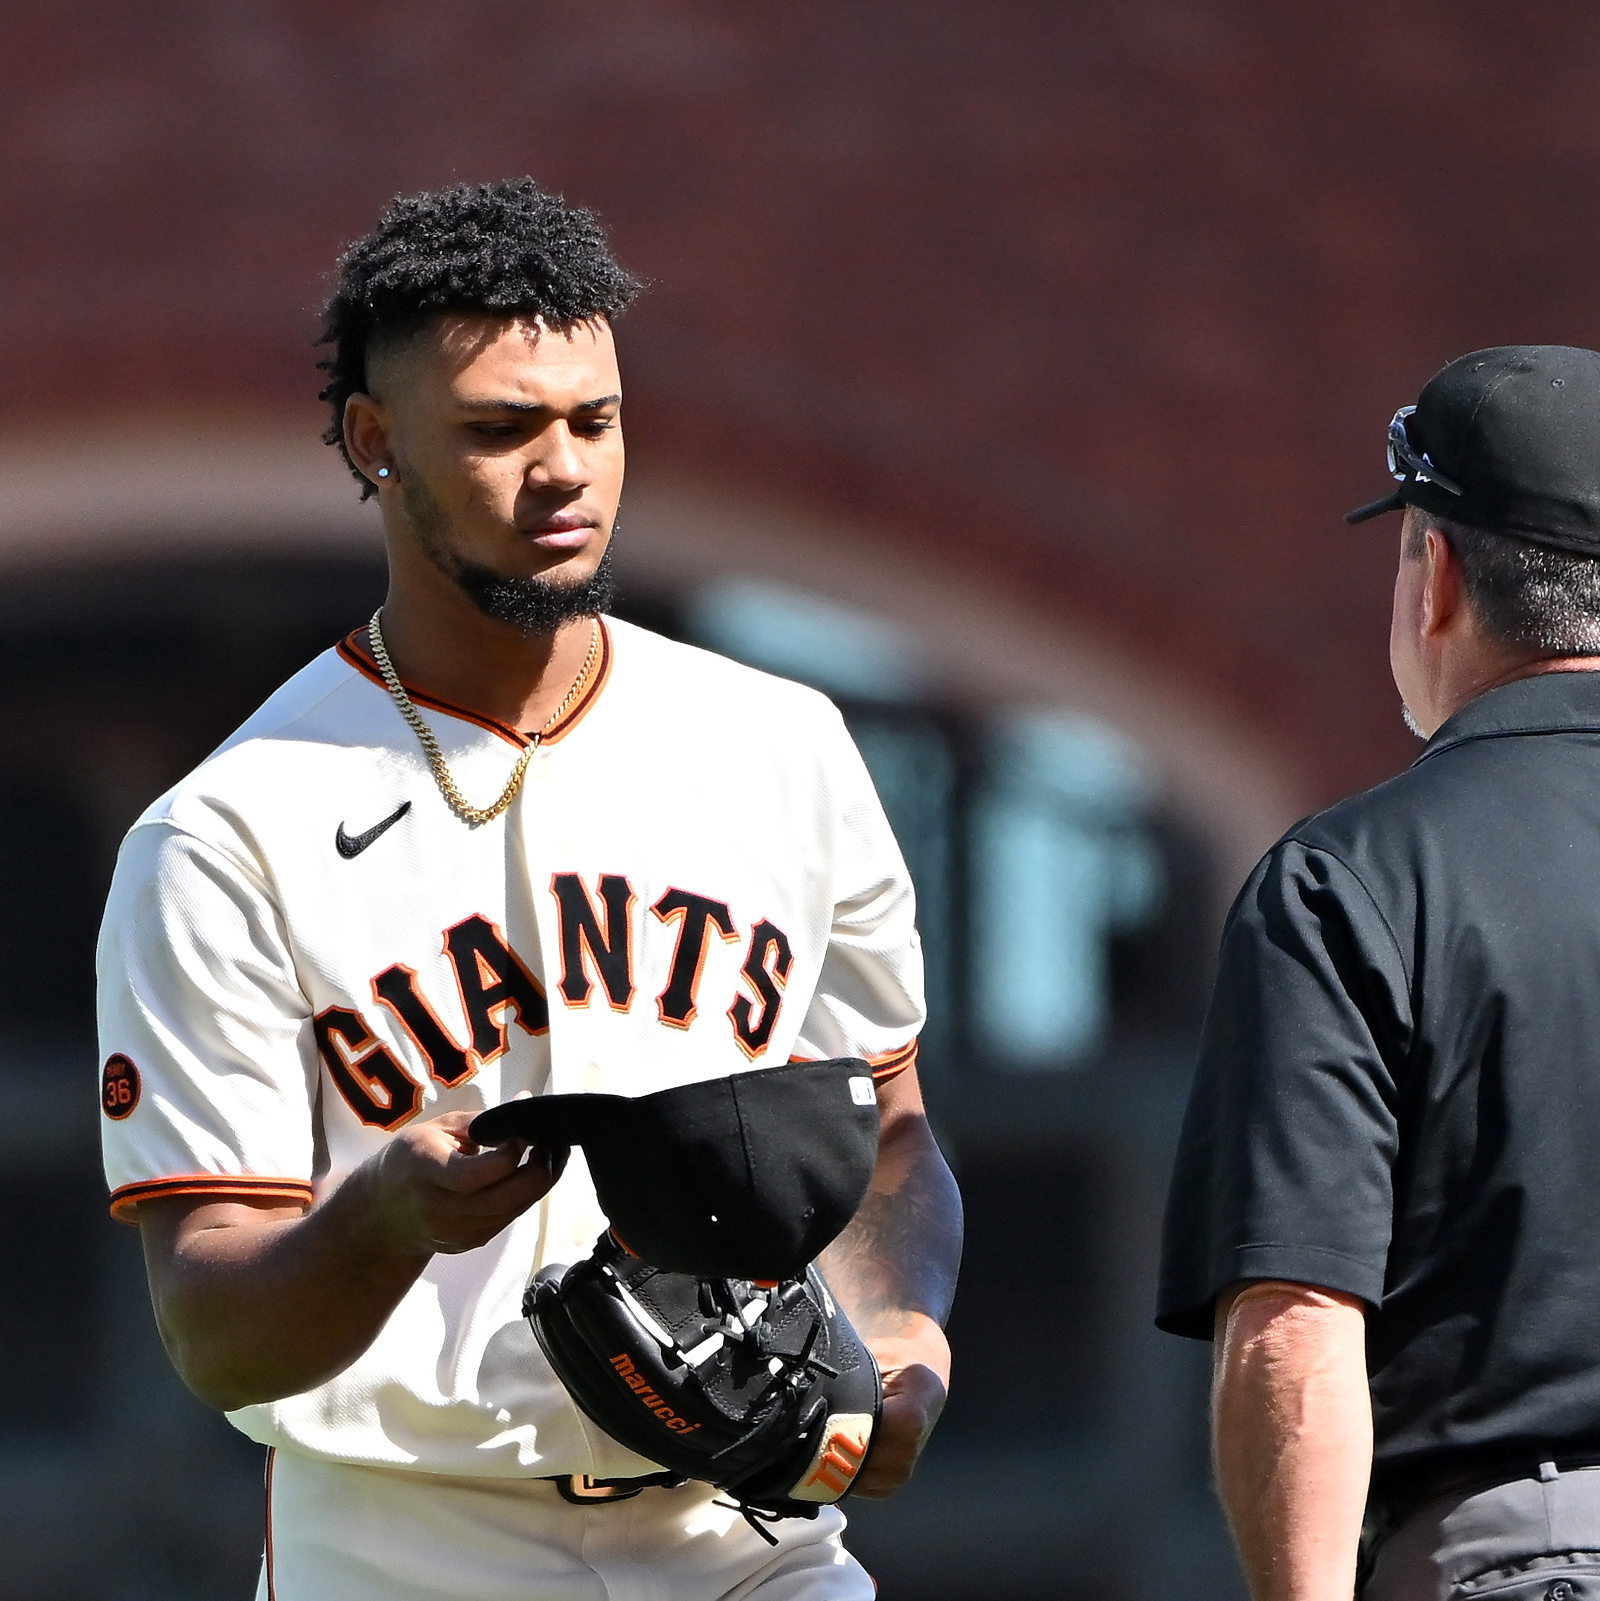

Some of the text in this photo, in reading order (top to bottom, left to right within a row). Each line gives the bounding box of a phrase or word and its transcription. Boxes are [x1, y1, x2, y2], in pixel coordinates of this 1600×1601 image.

[315, 872, 795, 1132] GIANTS
[106, 1078, 132, 1107] 36
[609, 1353, 700, 1436] marucci
